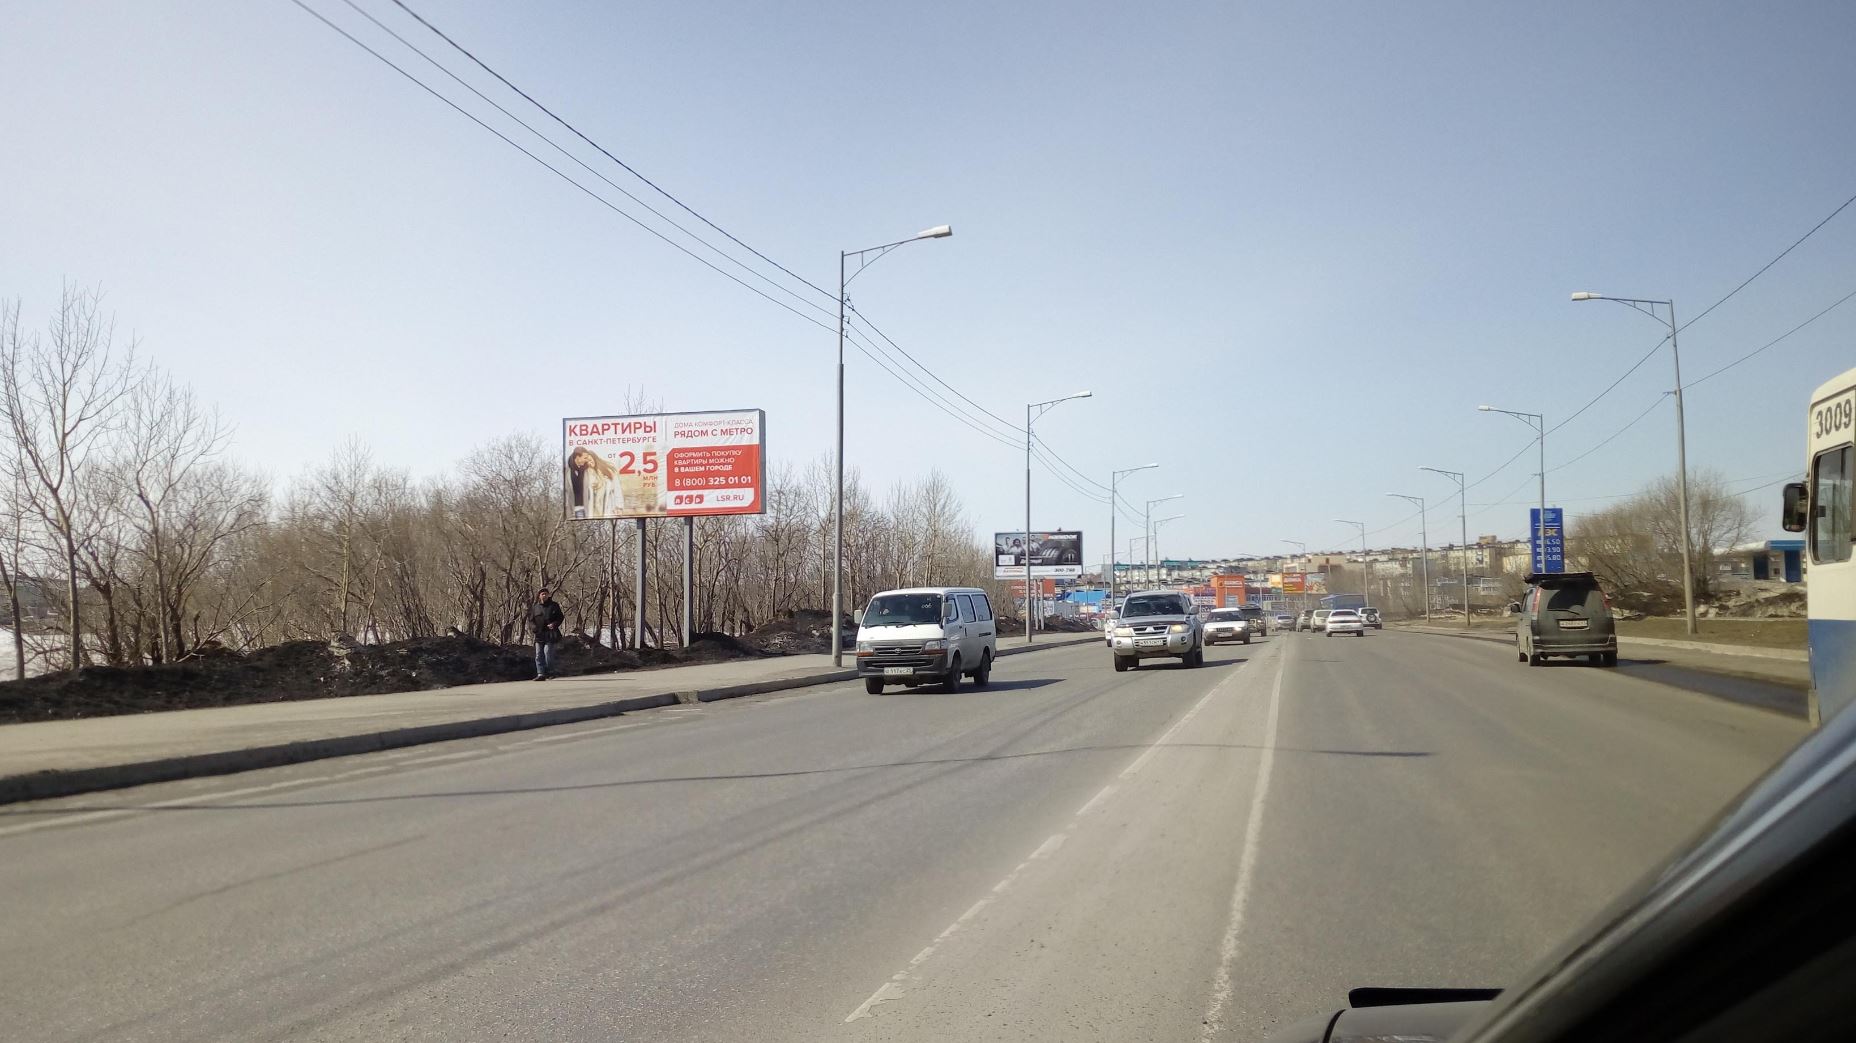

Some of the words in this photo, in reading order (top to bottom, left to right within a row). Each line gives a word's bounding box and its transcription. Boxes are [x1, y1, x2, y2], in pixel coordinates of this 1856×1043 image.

[1816, 399, 1852, 439] 3009
[569, 421, 656, 437] КВАРТИРЫ
[674, 421, 694, 429] ДОМА
[674, 429, 709, 439] РЯДОМ
[711, 428, 718, 436] С
[720, 427, 754, 437] МЕТРО
[576, 435, 657, 446] САНКТ-ПЕТЕРБУРГЕ
[674, 450, 711, 458] ОФОРМИТЬ
[711, 449, 743, 457] ПОКУПКУ
[619, 451, 658, 476] 2,5
[680, 465, 705, 473] ВАШЕМ
[706, 464, 734, 472] ГОРОДЕ
[674, 478, 681, 487] 8
[682, 477, 706, 487] (800)
[708, 476, 726, 485] 325
[728, 476, 739, 484] 01
[740, 475, 752, 484] 01
[716, 494, 744, 502] LSR.RU
